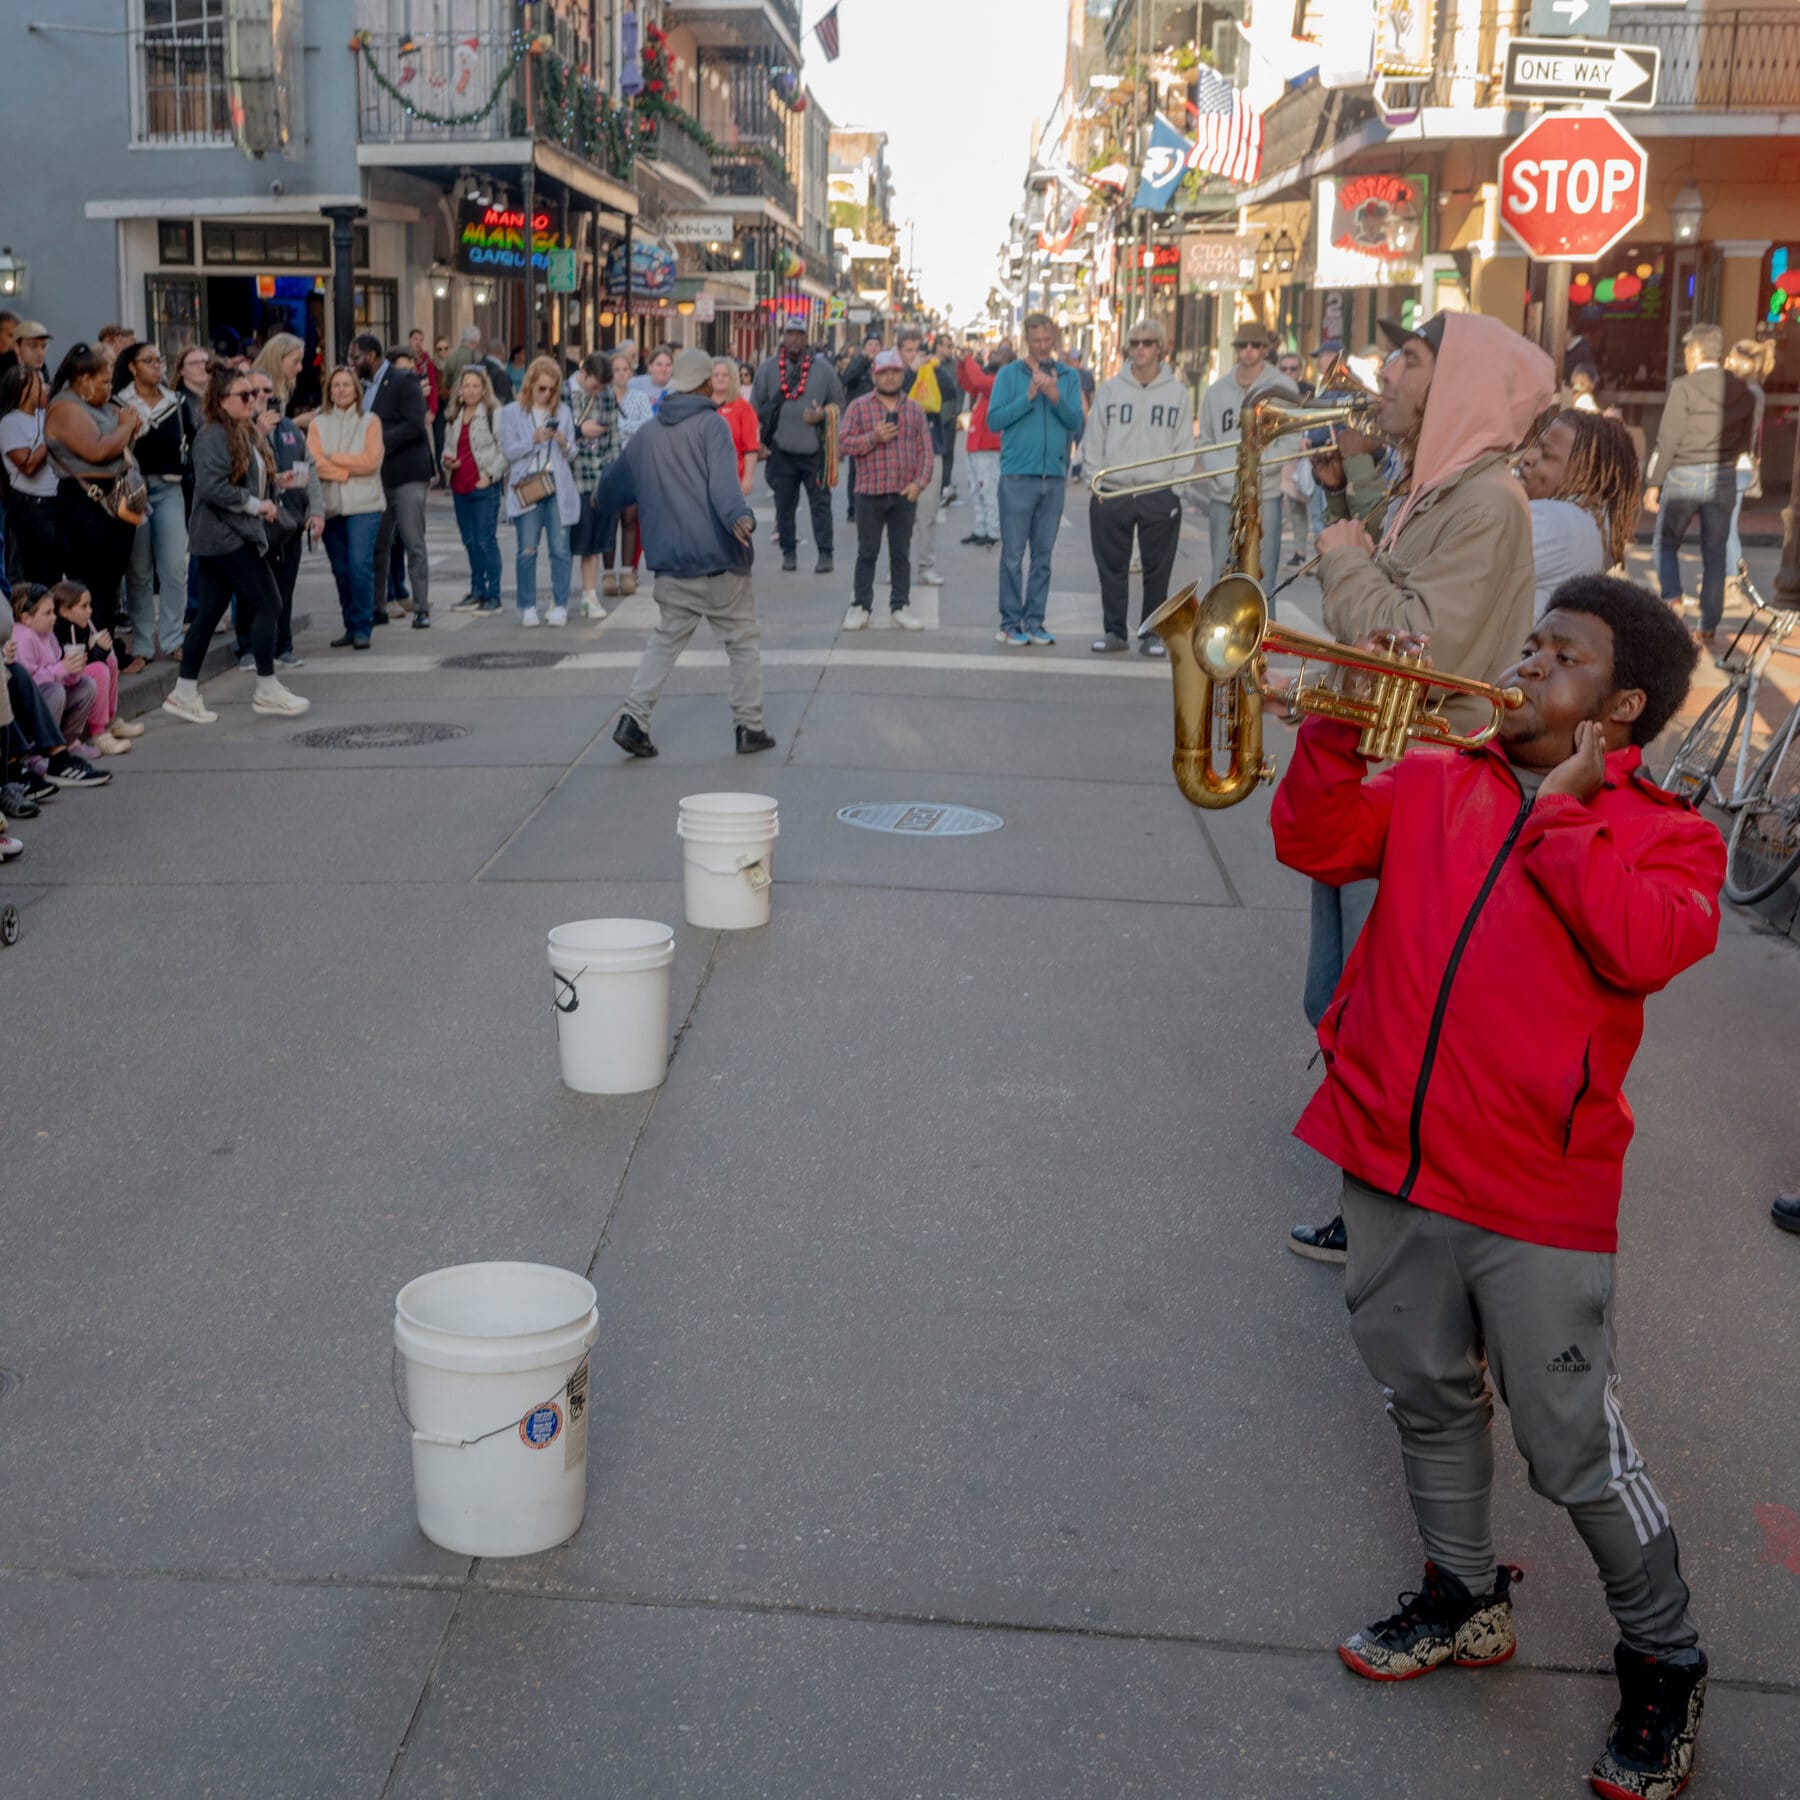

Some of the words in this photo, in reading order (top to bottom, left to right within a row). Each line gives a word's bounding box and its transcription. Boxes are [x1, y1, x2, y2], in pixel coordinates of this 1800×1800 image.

[1521, 60, 1563, 81] ONE
[1574, 62, 1613, 83] WAY
[1508, 159, 1635, 215] STOP
[484, 209, 549, 231] MANO
[1190, 245, 1246, 260] CIGA
[1546, 1362, 1592, 1373] adidas
